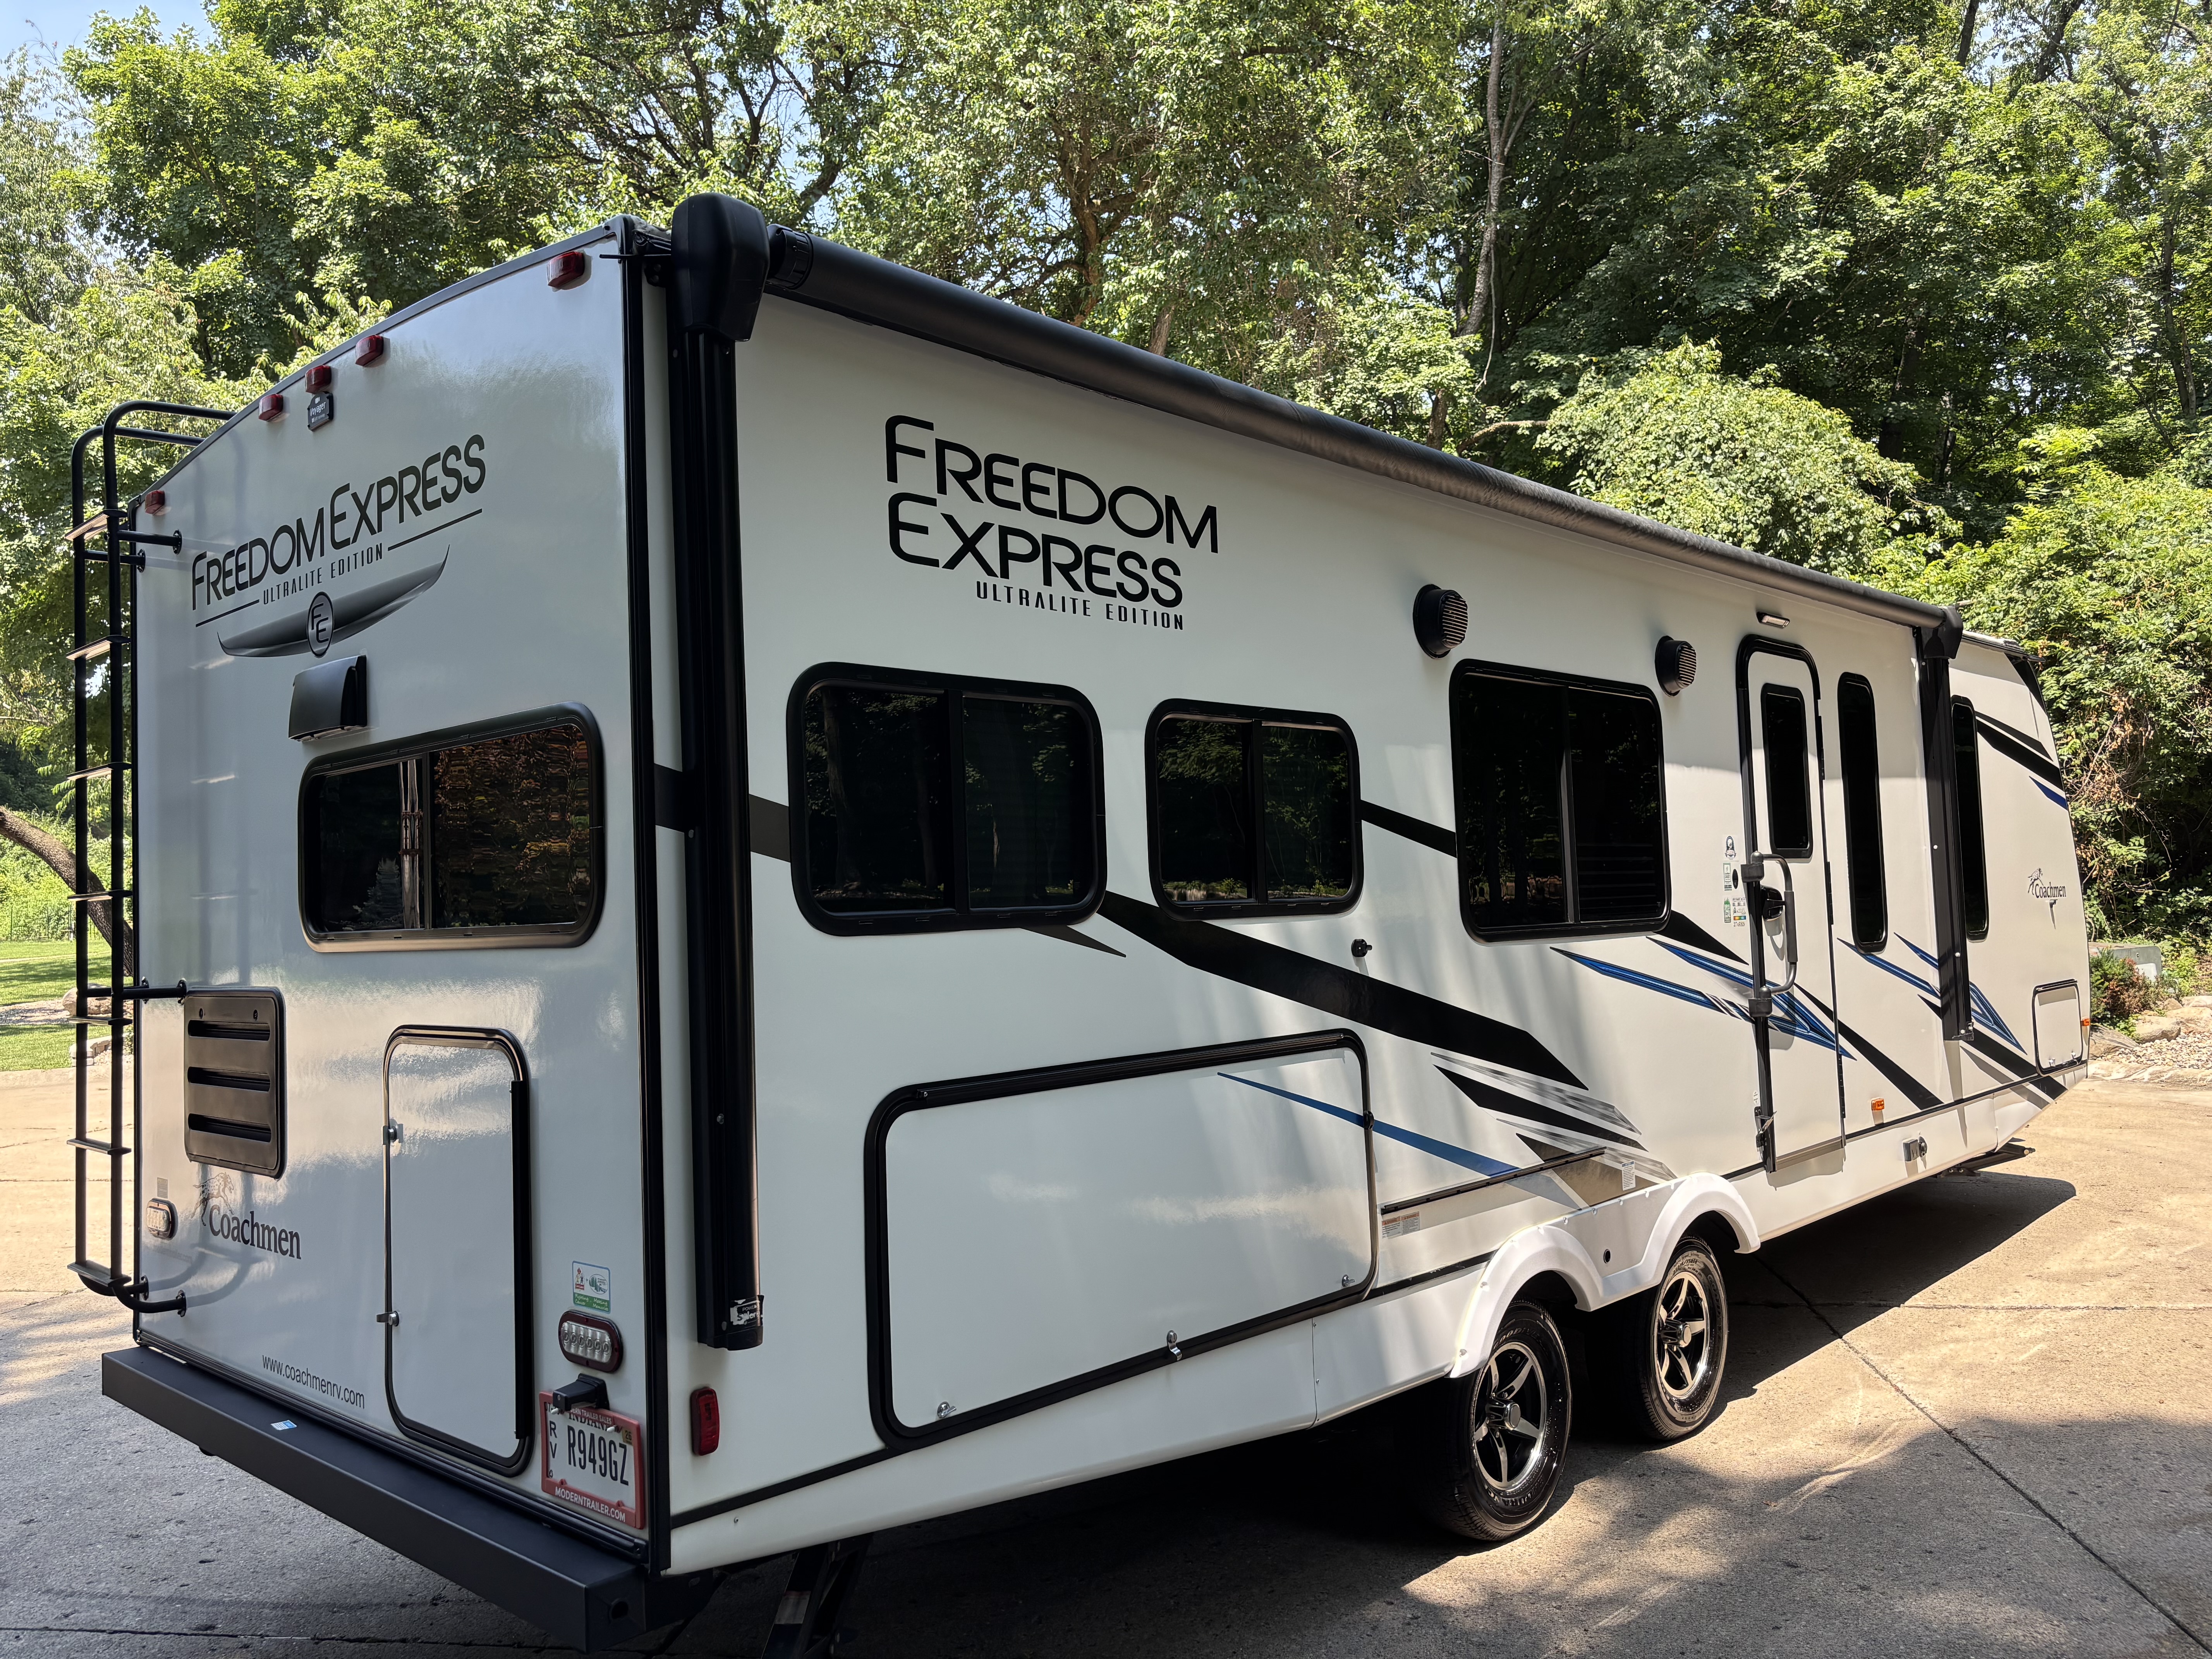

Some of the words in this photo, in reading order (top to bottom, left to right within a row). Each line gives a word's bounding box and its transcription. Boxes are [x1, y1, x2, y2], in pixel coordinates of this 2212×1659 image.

[310, 402, 326, 416] Voyager
[885, 415, 1218, 554] FREEDOM
[192, 507, 325, 611] FREEDOM
[330, 434, 486, 550] EXPRESS
[263, 566, 322, 605] ULTRALITE
[331, 543, 383, 579] EDITION
[888, 492, 1183, 608] EXPRESS
[977, 581, 1091, 617] ULTRALITE
[1106, 603, 1183, 630] EDITION
[2035, 881, 2066, 898] Coachmen
[210, 1204, 301, 1259] Coachmen
[262, 1355, 365, 1409] www.coachmenrv.com
[581, 1410, 599, 1420] TRAILER
[599, 1415, 612, 1425] SALES
[625, 1430, 632, 1440] 26
[567, 1425, 629, 1486] R949GZ
[555, 1486, 626, 1523] MODERNTRAILER.COM
